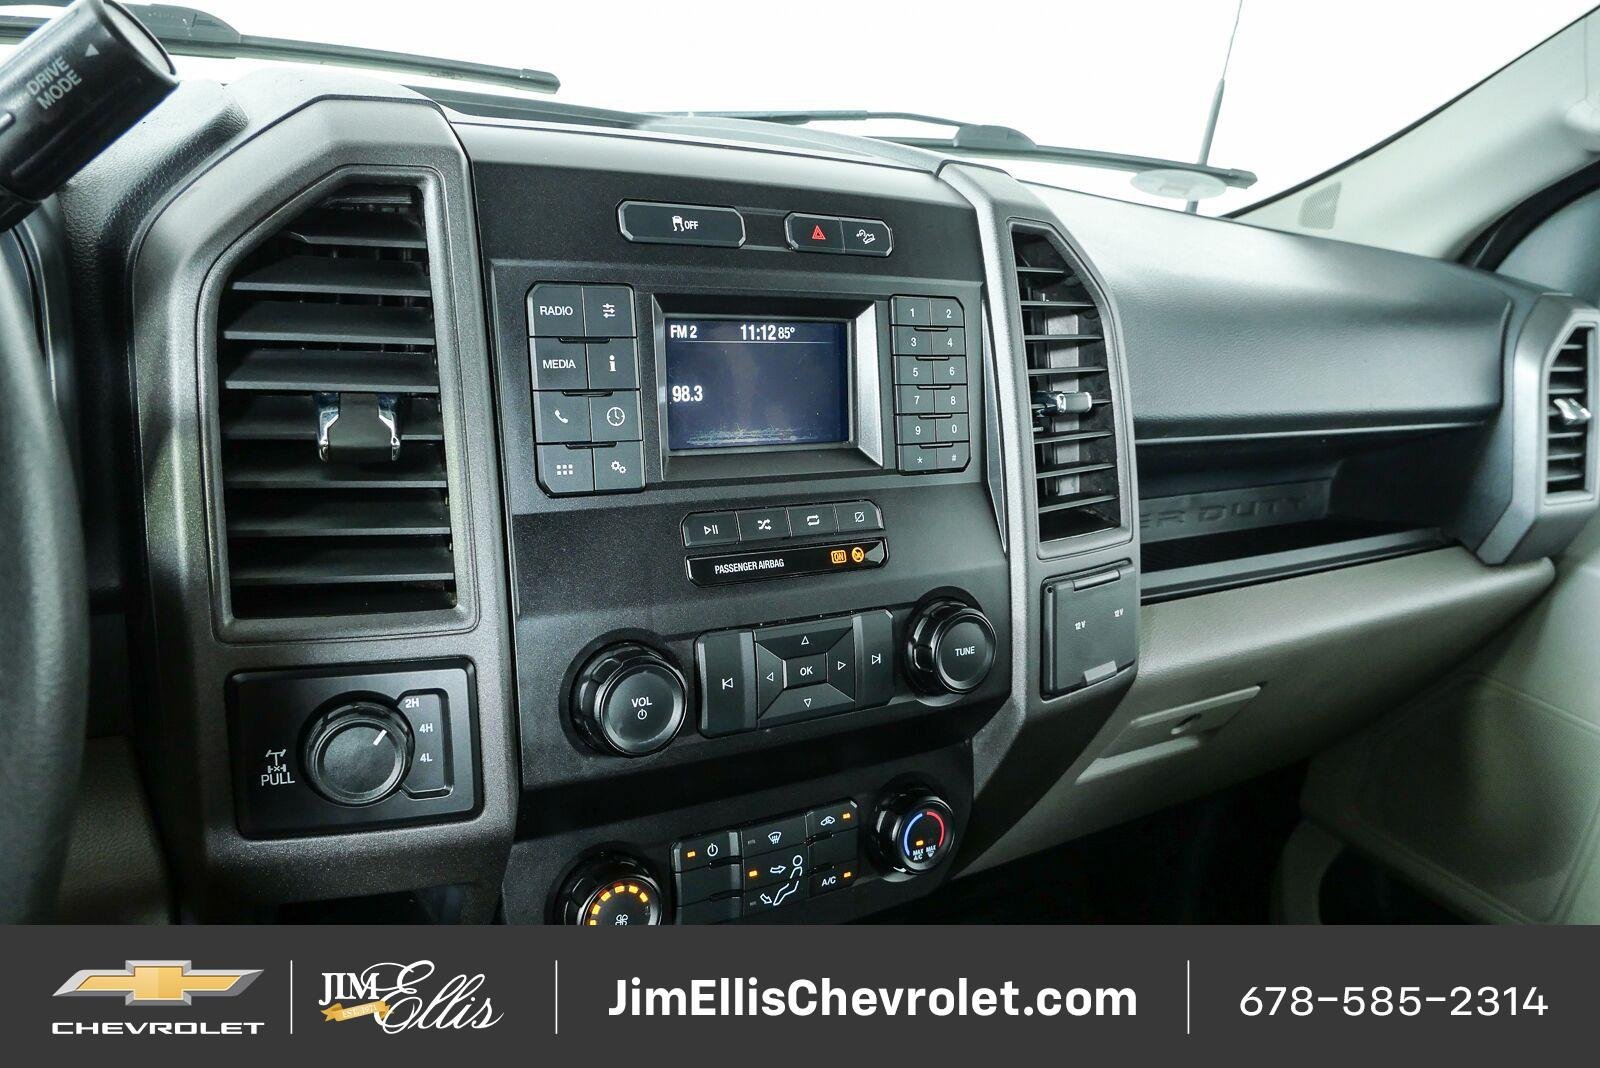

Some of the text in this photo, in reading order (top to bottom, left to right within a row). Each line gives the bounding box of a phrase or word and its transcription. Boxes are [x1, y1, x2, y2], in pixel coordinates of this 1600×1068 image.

[26, 55, 70, 96] DRIVE
[36, 69, 82, 110] MODE
[684, 220, 699, 230] OFF
[539, 305, 574, 316] RADIO
[909, 308, 915, 318] 1
[945, 308, 952, 319] 2
[670, 324, 698, 339] FM 2
[740, 324, 777, 341] 11:12
[910, 337, 917, 347] 3
[946, 337, 953, 347] 4
[542, 358, 577, 369] MEDIA
[912, 367, 919, 377] 5
[949, 366, 955, 376] 6
[671, 384, 704, 403] 98.3
[913, 395, 920, 405] 7
[950, 395, 957, 405] 8
[915, 425, 921, 436] 9
[951, 424, 958, 434] 0
[714, 562, 758, 575] PASSENGER
[758, 558, 785, 571] AIRBAG
[954, 646, 976, 657] TUNE
[799, 666, 814, 677] OK
[404, 698, 420, 709] 2H
[631, 696, 653, 708] VOL
[418, 723, 434, 734] 4H
[419, 753, 433, 763] 4L
[260, 773, 296, 787] PULL
[821, 875, 837, 887] A/C
